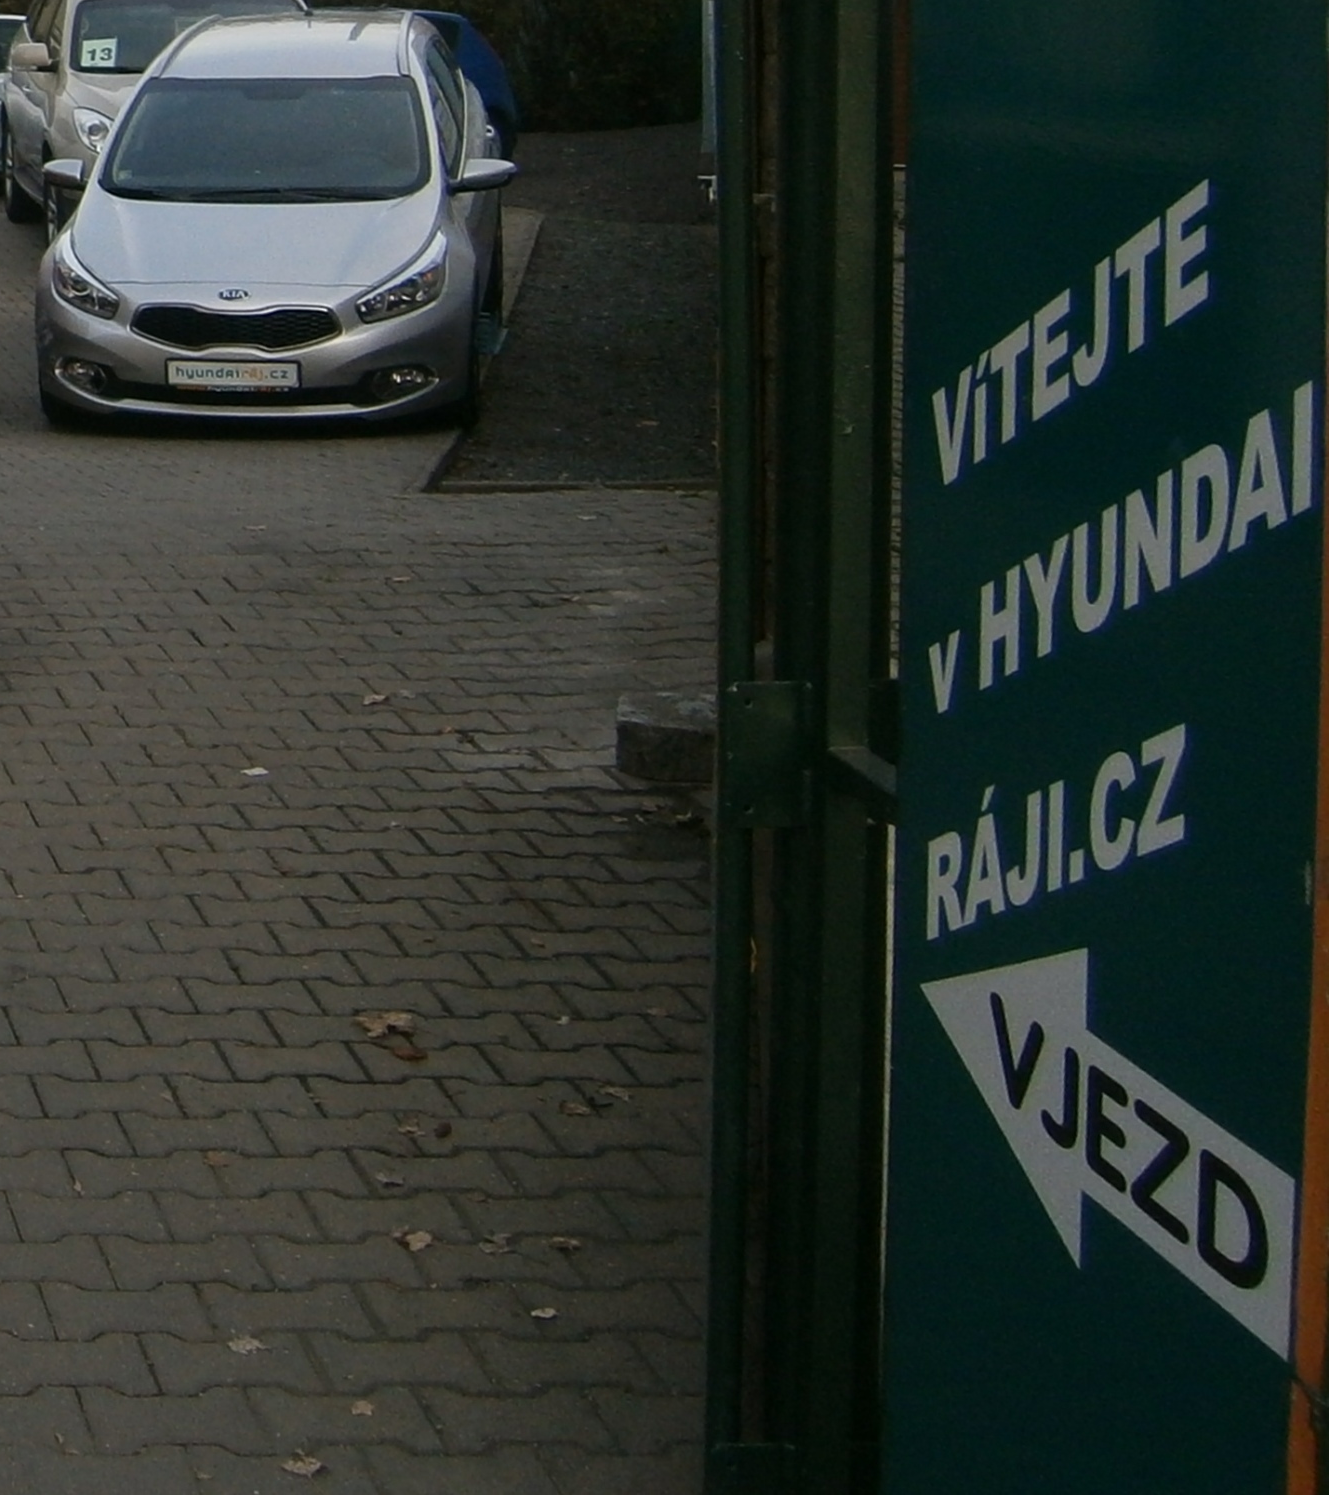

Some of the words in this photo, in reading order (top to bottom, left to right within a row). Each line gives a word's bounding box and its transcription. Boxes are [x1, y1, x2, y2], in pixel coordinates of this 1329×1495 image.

[86, 47, 114, 61] 13
[222, 289, 246, 300] KIA
[931, 177, 1210, 487] VÍTEJTE
[979, 380, 1313, 692] HYUNDAI
[927, 722, 1187, 942] RÁJI.CZ
[989, 991, 1270, 1292] VJEZD
